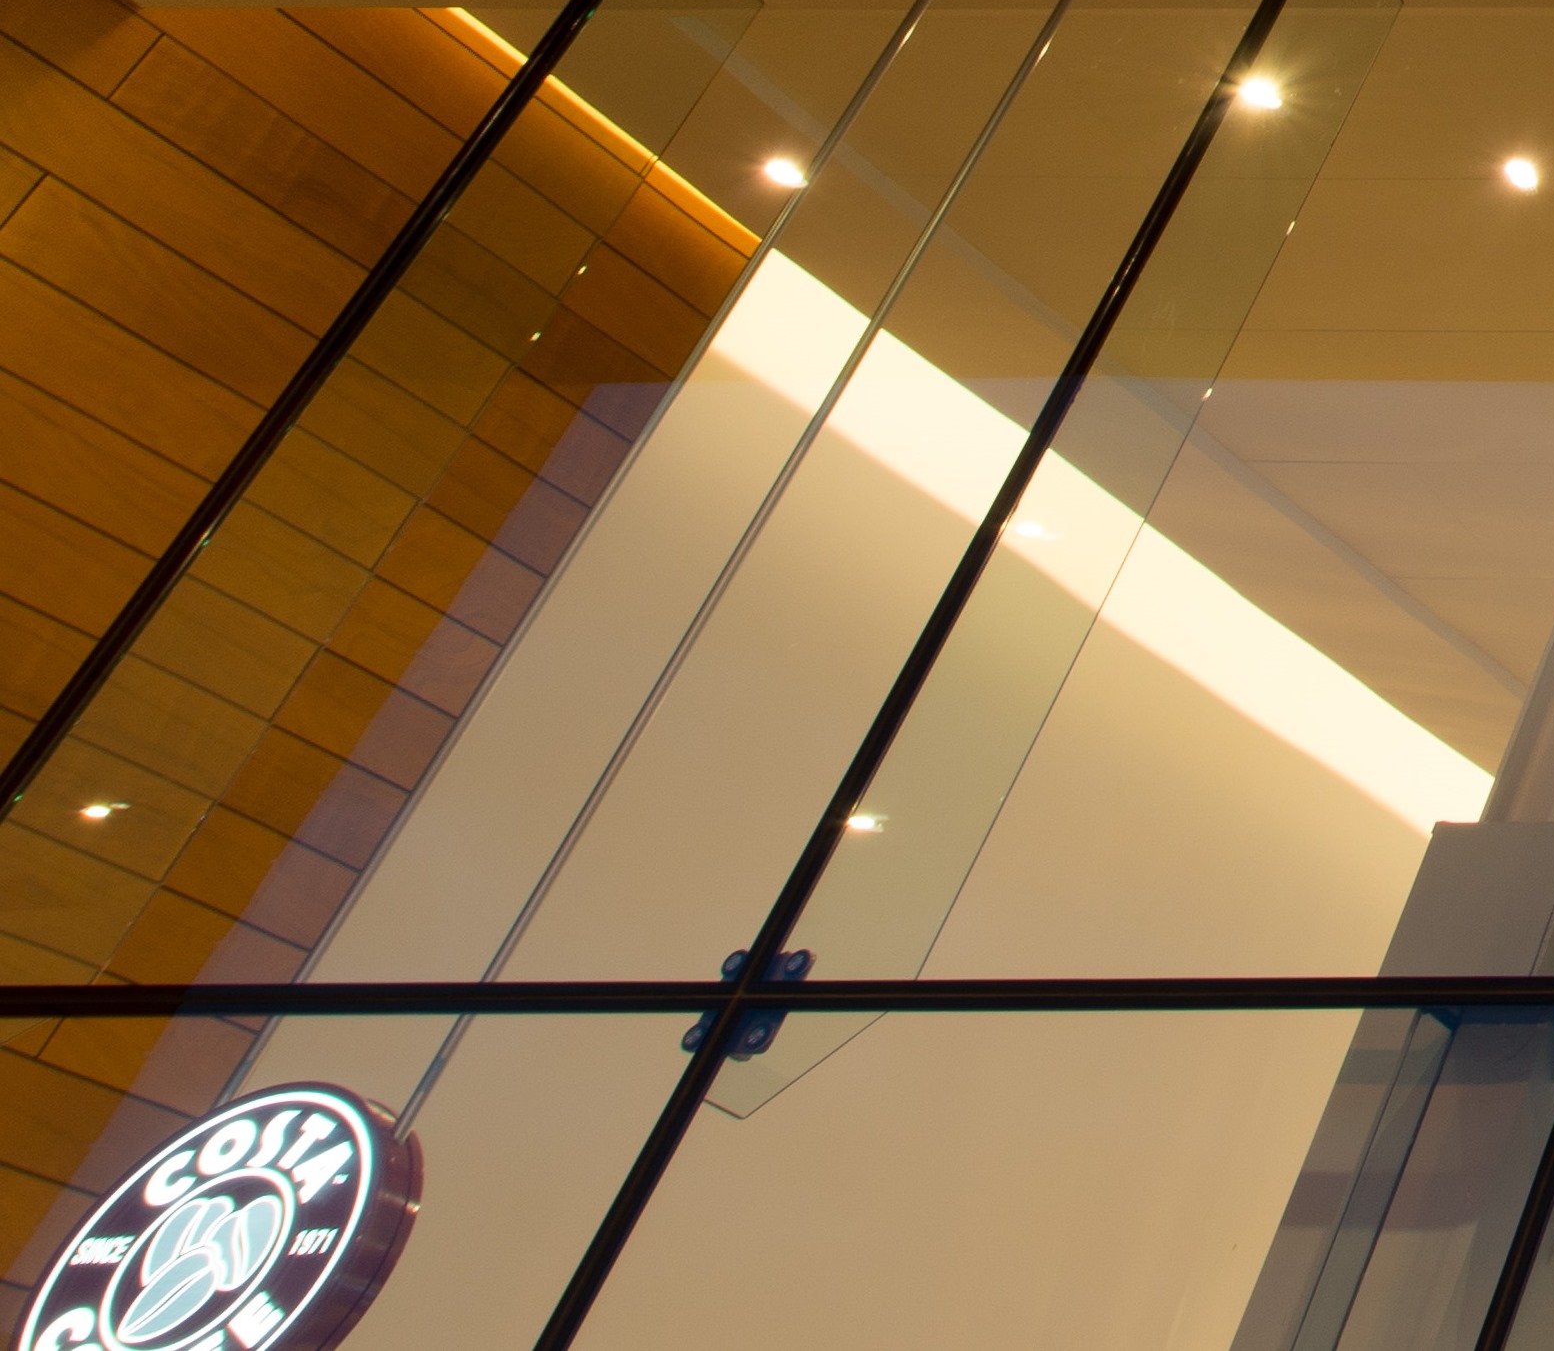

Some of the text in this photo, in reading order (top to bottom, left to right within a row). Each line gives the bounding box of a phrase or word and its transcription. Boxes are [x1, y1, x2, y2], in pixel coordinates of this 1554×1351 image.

[144, 1109, 354, 1207] COSTA
[70, 1228, 338, 1266] SINCE 1971
